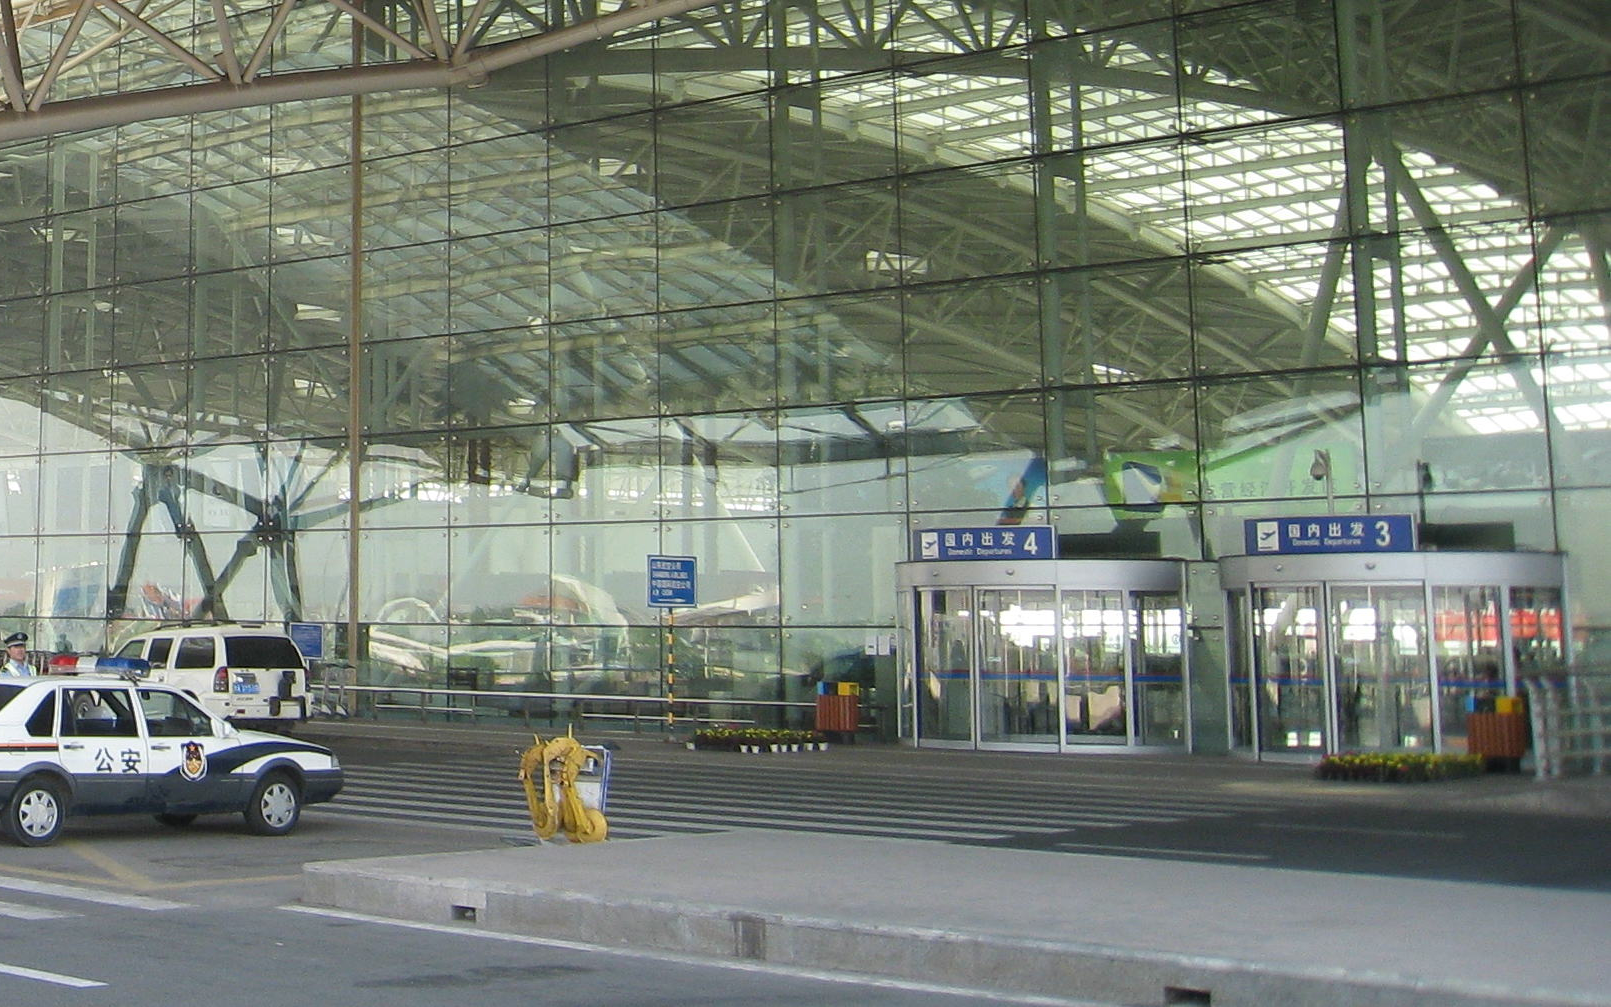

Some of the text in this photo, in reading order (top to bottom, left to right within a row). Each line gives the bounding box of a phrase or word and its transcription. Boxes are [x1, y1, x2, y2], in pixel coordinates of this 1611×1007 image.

[944, 531, 1038, 555] 国内出发 4
[1288, 520, 1390, 547] 国内出发 3
[1324, 538, 1361, 546] Departures
[95, 747, 141, 775] 公安
